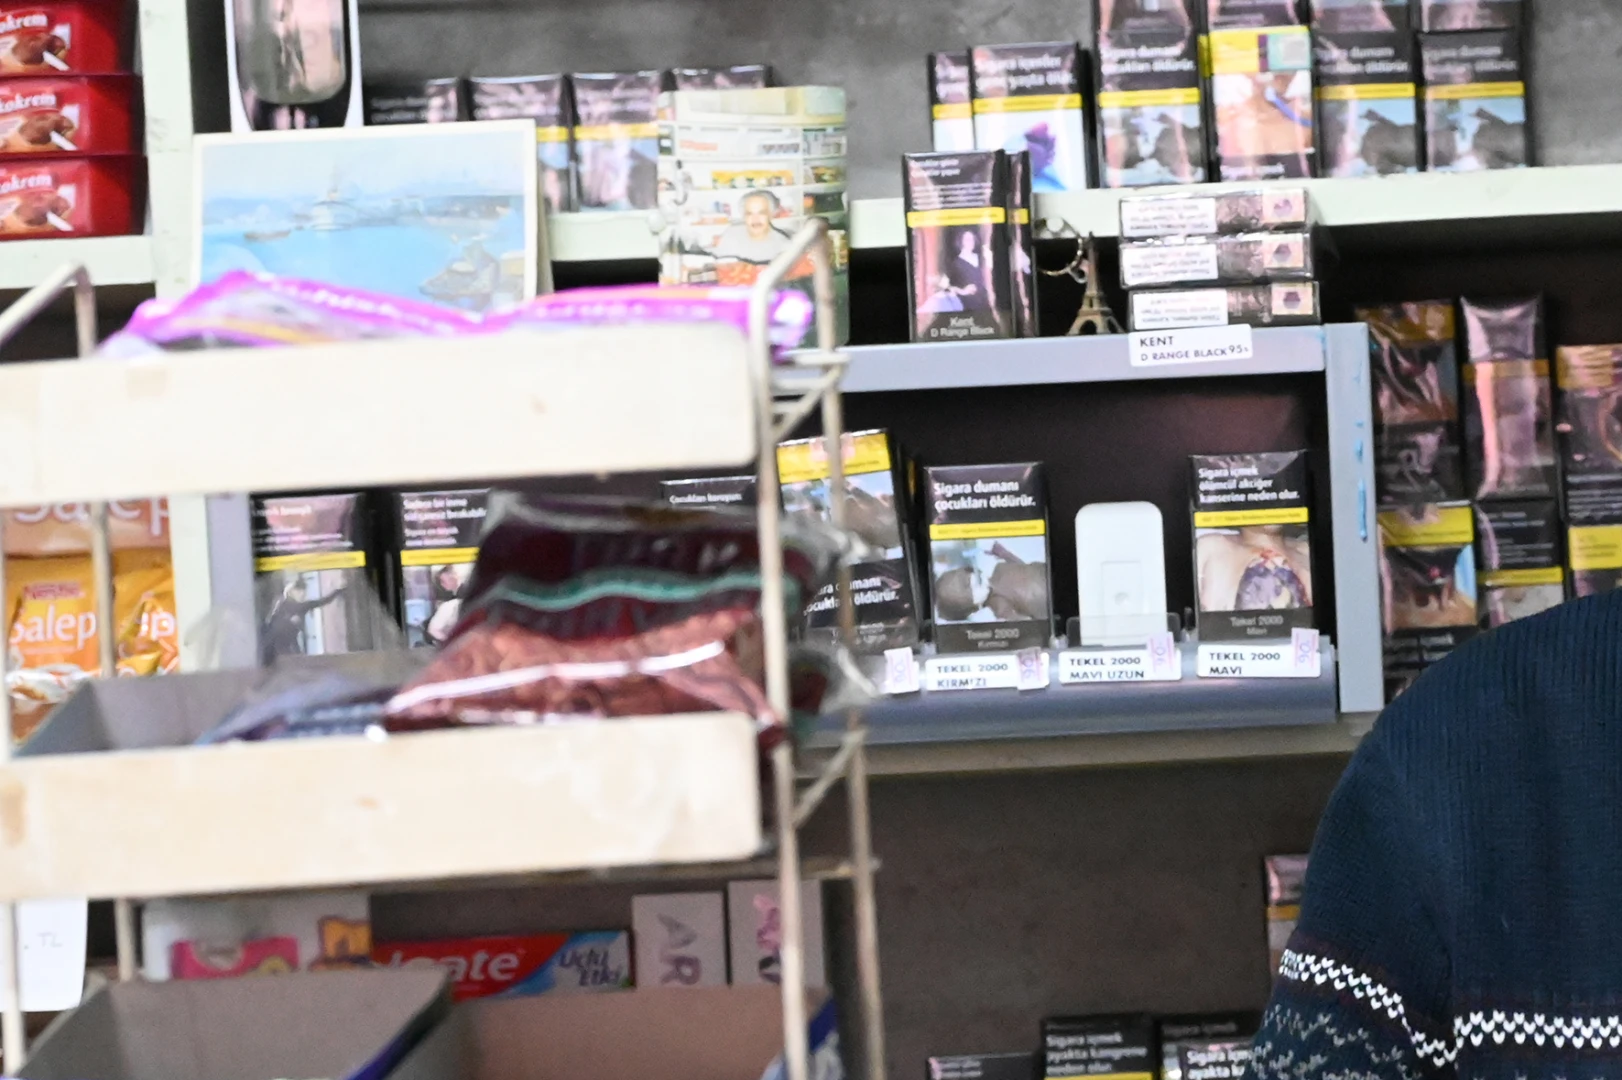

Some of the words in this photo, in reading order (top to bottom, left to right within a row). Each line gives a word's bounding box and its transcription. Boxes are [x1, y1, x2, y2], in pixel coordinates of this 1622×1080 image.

[1139, 335, 1175, 348] KENT
[1140, 353, 1149, 362] D
[1152, 350, 1190, 362] RANGE
[1193, 347, 1228, 359] BLACK
[1198, 468, 1229, 480] Sigara
[1230, 466, 1259, 478] içmek
[934, 481, 972, 498] Sigara
[973, 480, 1020, 494] dumanı
[1247, 490, 1278, 503] neden
[934, 497, 989, 514] çocukları
[990, 494, 1036, 510] öldürür.
[854, 590, 900, 607] öldürür.
[1258, 614, 1284, 626] 2000
[994, 627, 1021, 639] 2000
[1069, 657, 1106, 667] TEKEL
[1111, 656, 1142, 666] 2000
[1209, 652, 1246, 661] TEKEL
[1250, 651, 1281, 661] 2000
[937, 663, 972, 675] TEKEL
[977, 661, 1009, 672] 2000
[1107, 669, 1145, 679] UZUN
[1186, 1050, 1226, 1066] Sigara
